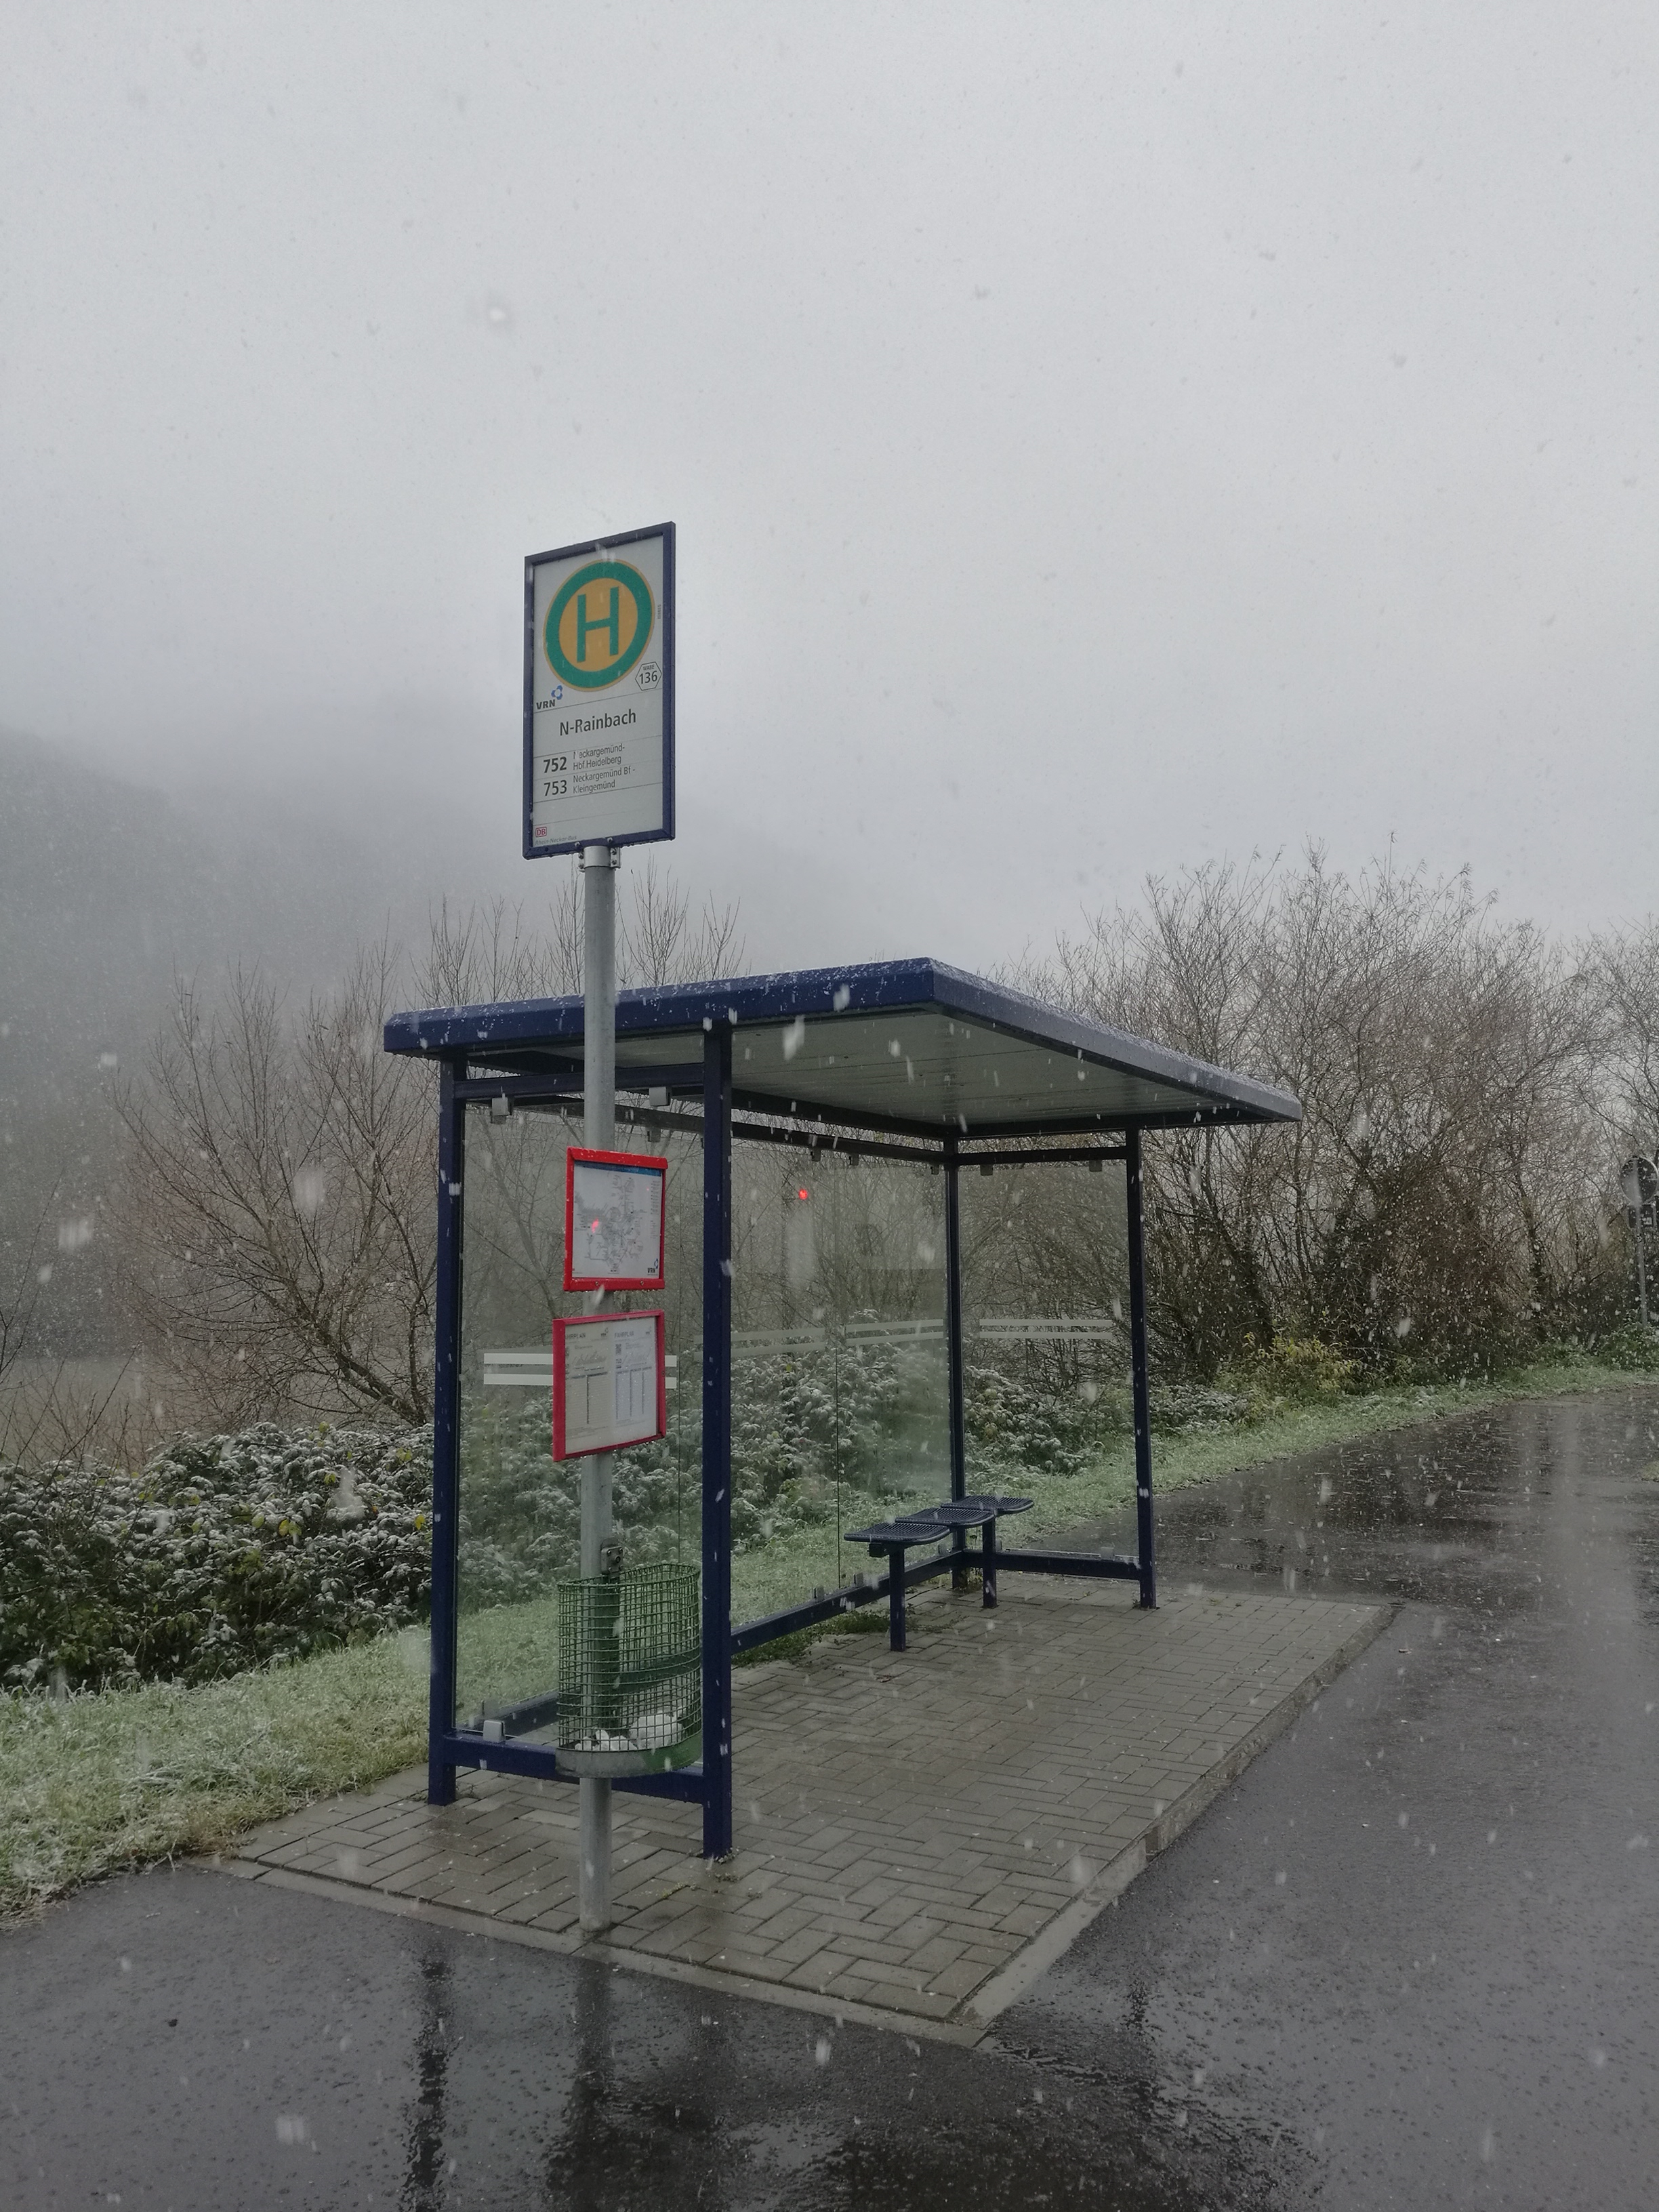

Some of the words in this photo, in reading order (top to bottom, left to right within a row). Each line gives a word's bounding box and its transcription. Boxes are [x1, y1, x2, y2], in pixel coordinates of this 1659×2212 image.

[577, 586, 619, 663] H
[639, 670, 658, 684] 136
[536, 699, 556, 710] VRN
[559, 708, 636, 736] N-Rainbach
[543, 756, 567, 774] 752
[573, 767, 622, 783] Neckargemünd
[623, 766, 632, 775] Bf
[544, 779, 567, 797] 753
[573, 780, 616, 794] Kleingemünd
[537, 828, 546, 836] DB
